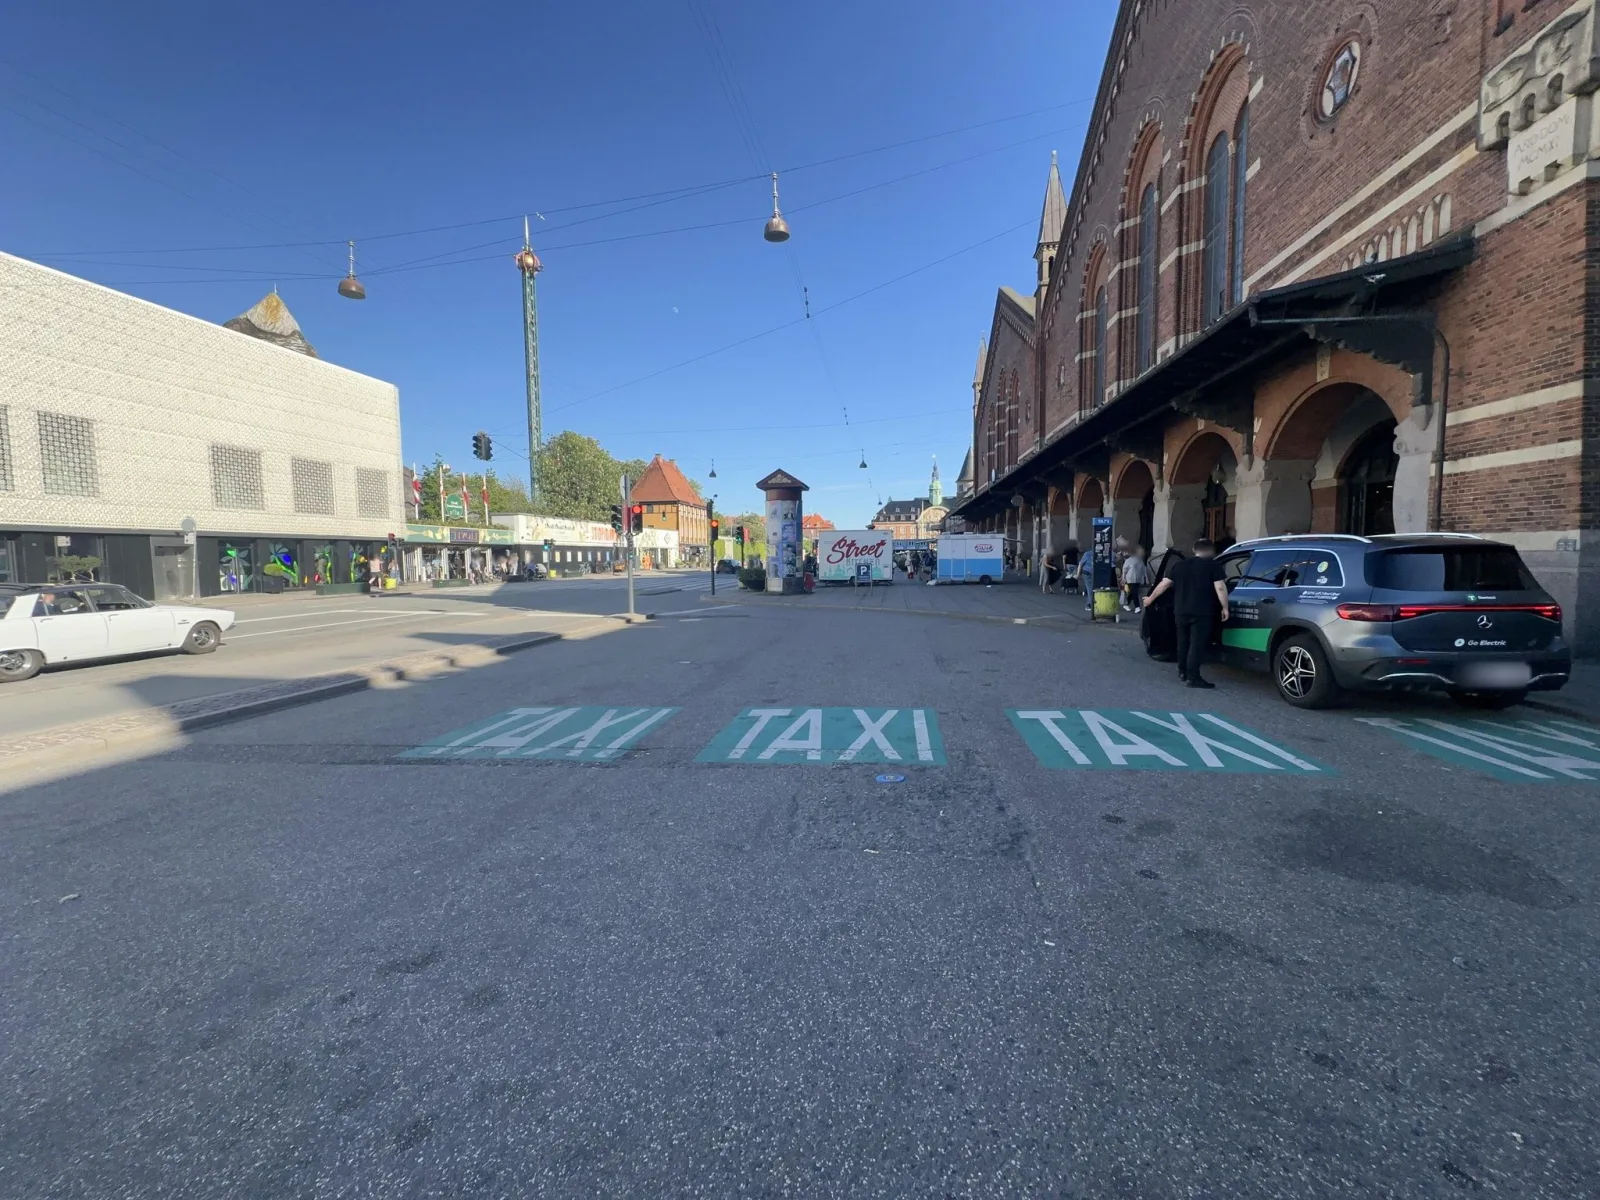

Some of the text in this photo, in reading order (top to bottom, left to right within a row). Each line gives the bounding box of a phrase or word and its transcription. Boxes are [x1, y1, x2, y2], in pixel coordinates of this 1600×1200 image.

[826, 535, 887, 564] Street
[860, 566, 867, 576] P
[429, 707, 673, 758] TAXI
[727, 708, 934, 762] TAXI
[1016, 710, 1322, 771] TAXI
